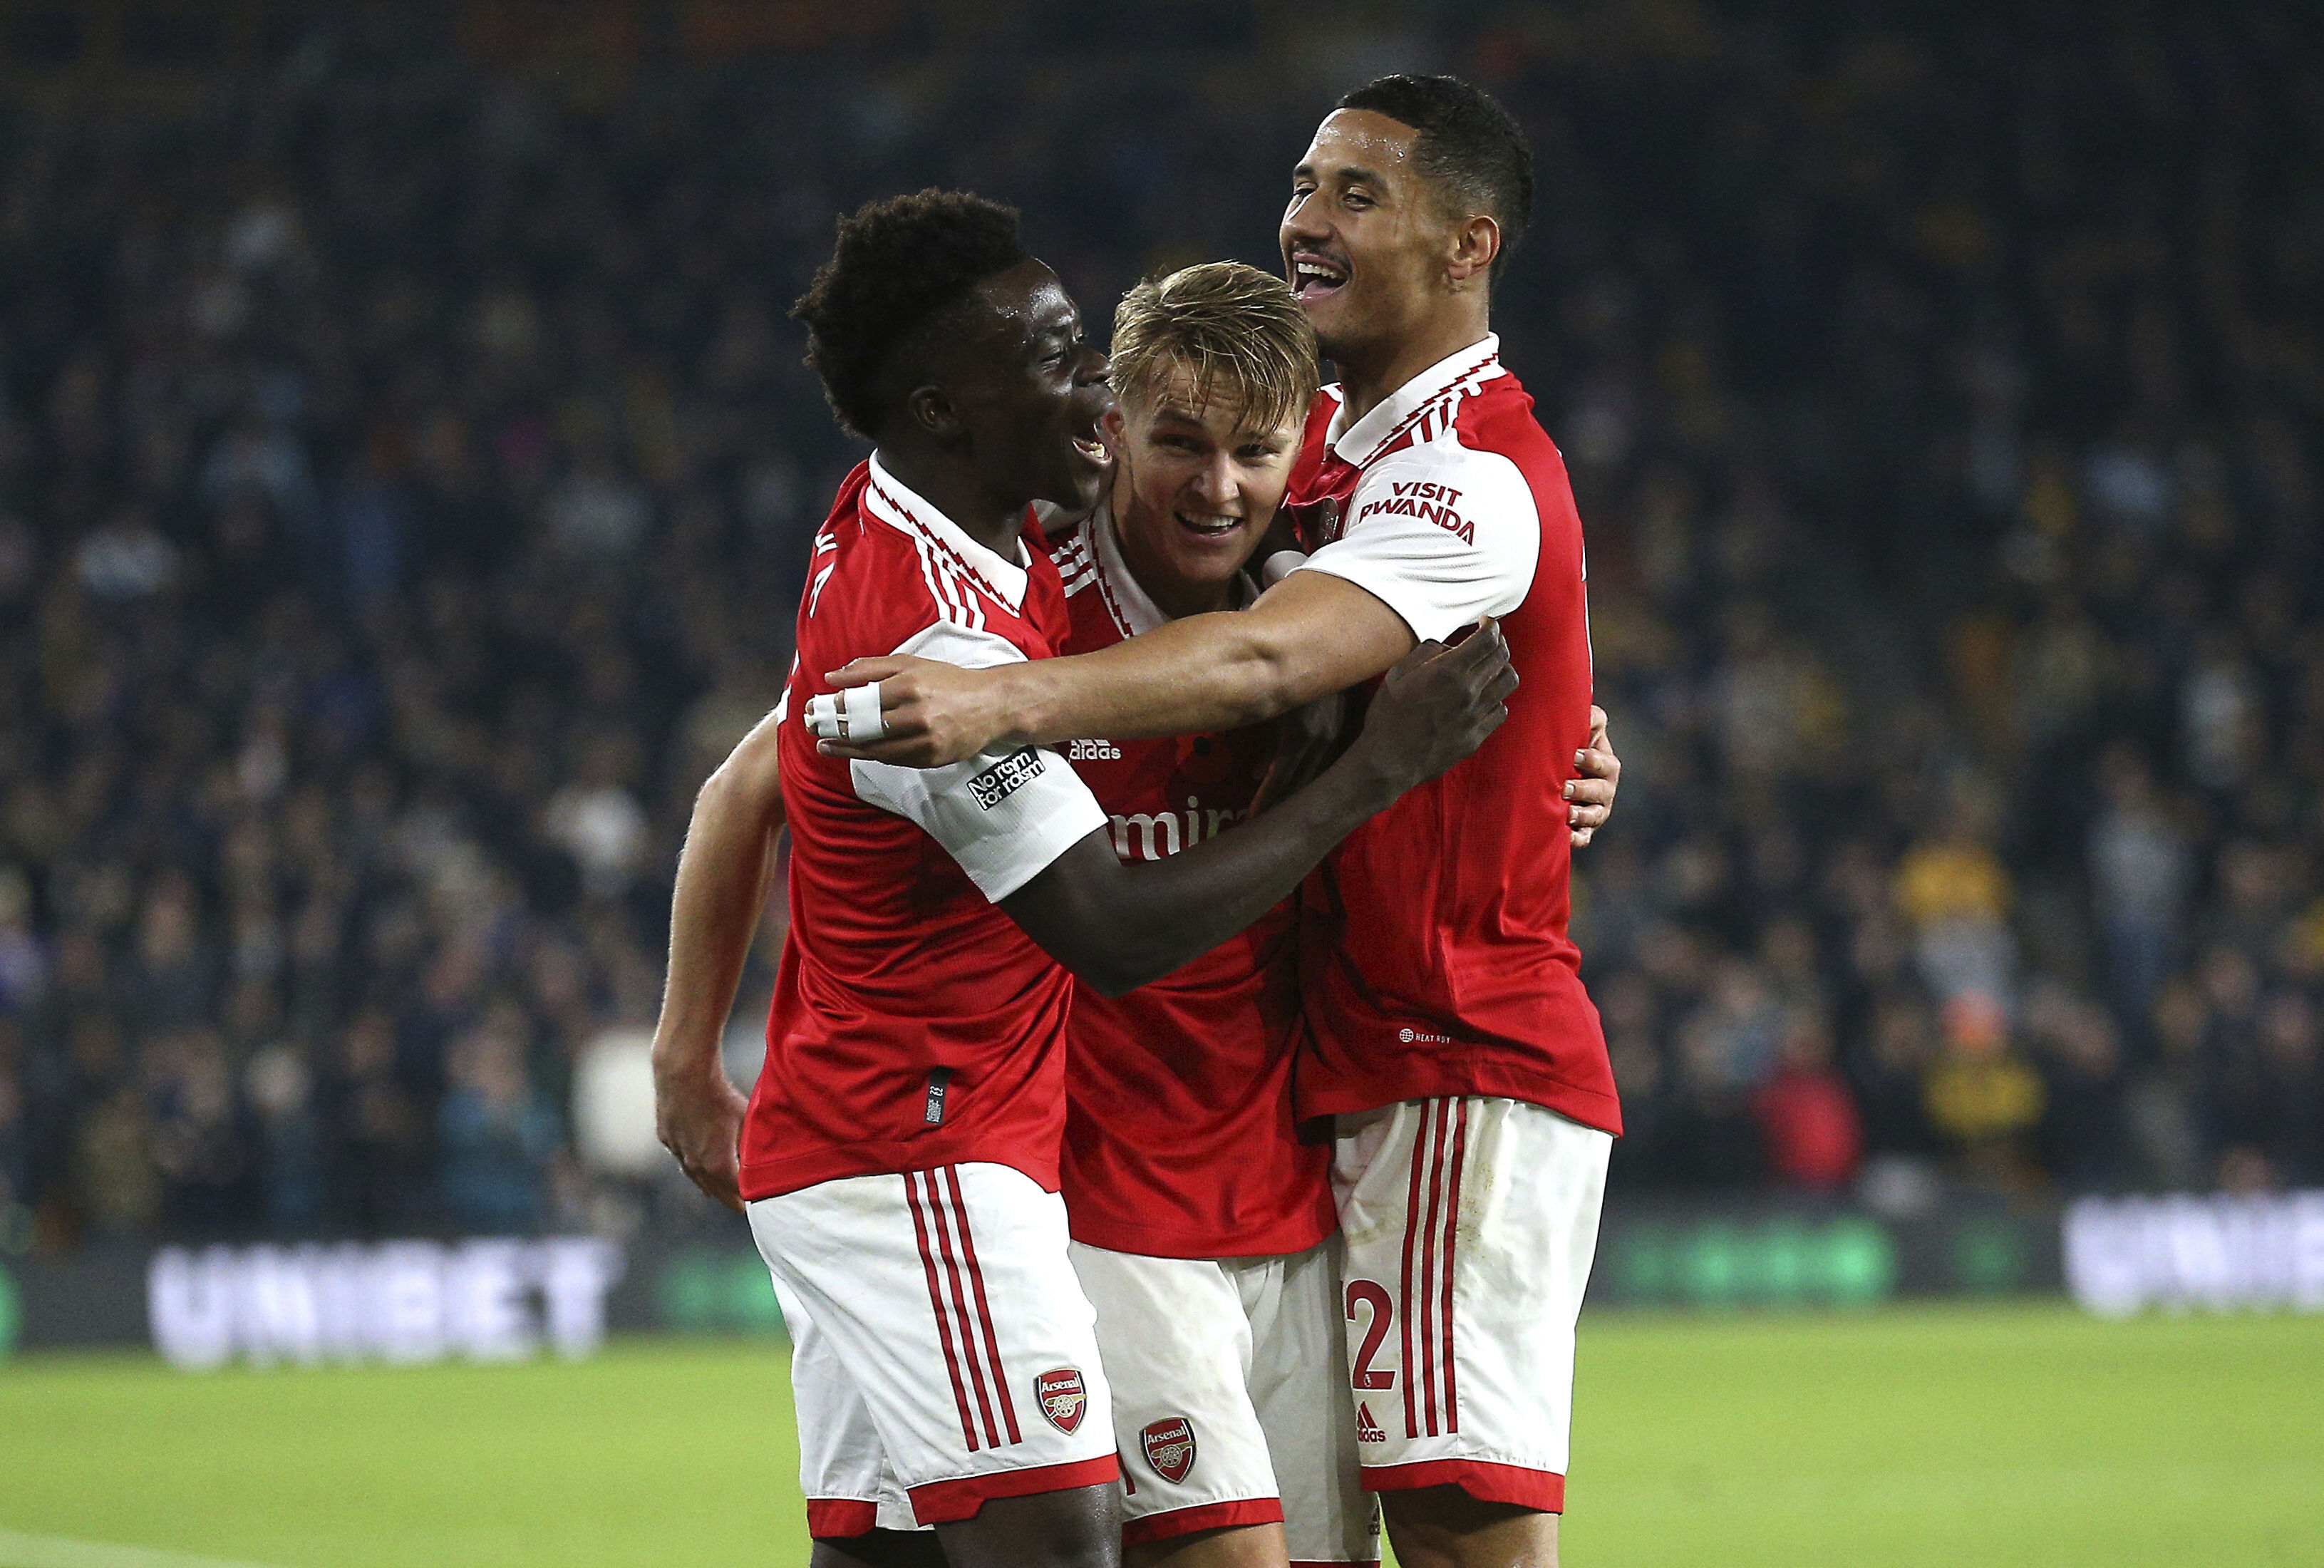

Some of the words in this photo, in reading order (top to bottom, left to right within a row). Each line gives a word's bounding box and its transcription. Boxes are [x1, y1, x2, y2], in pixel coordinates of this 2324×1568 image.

[1392, 482, 1463, 505] VISIT
[1359, 498, 1475, 547] RWANDA
[1069, 743, 1122, 760] didas
[968, 775, 996, 798] No
[148, 1240, 621, 1368] UNIBET
[1041, 1376, 1079, 1393] Arsenal
[1147, 1426, 1185, 1445] Arsenal
